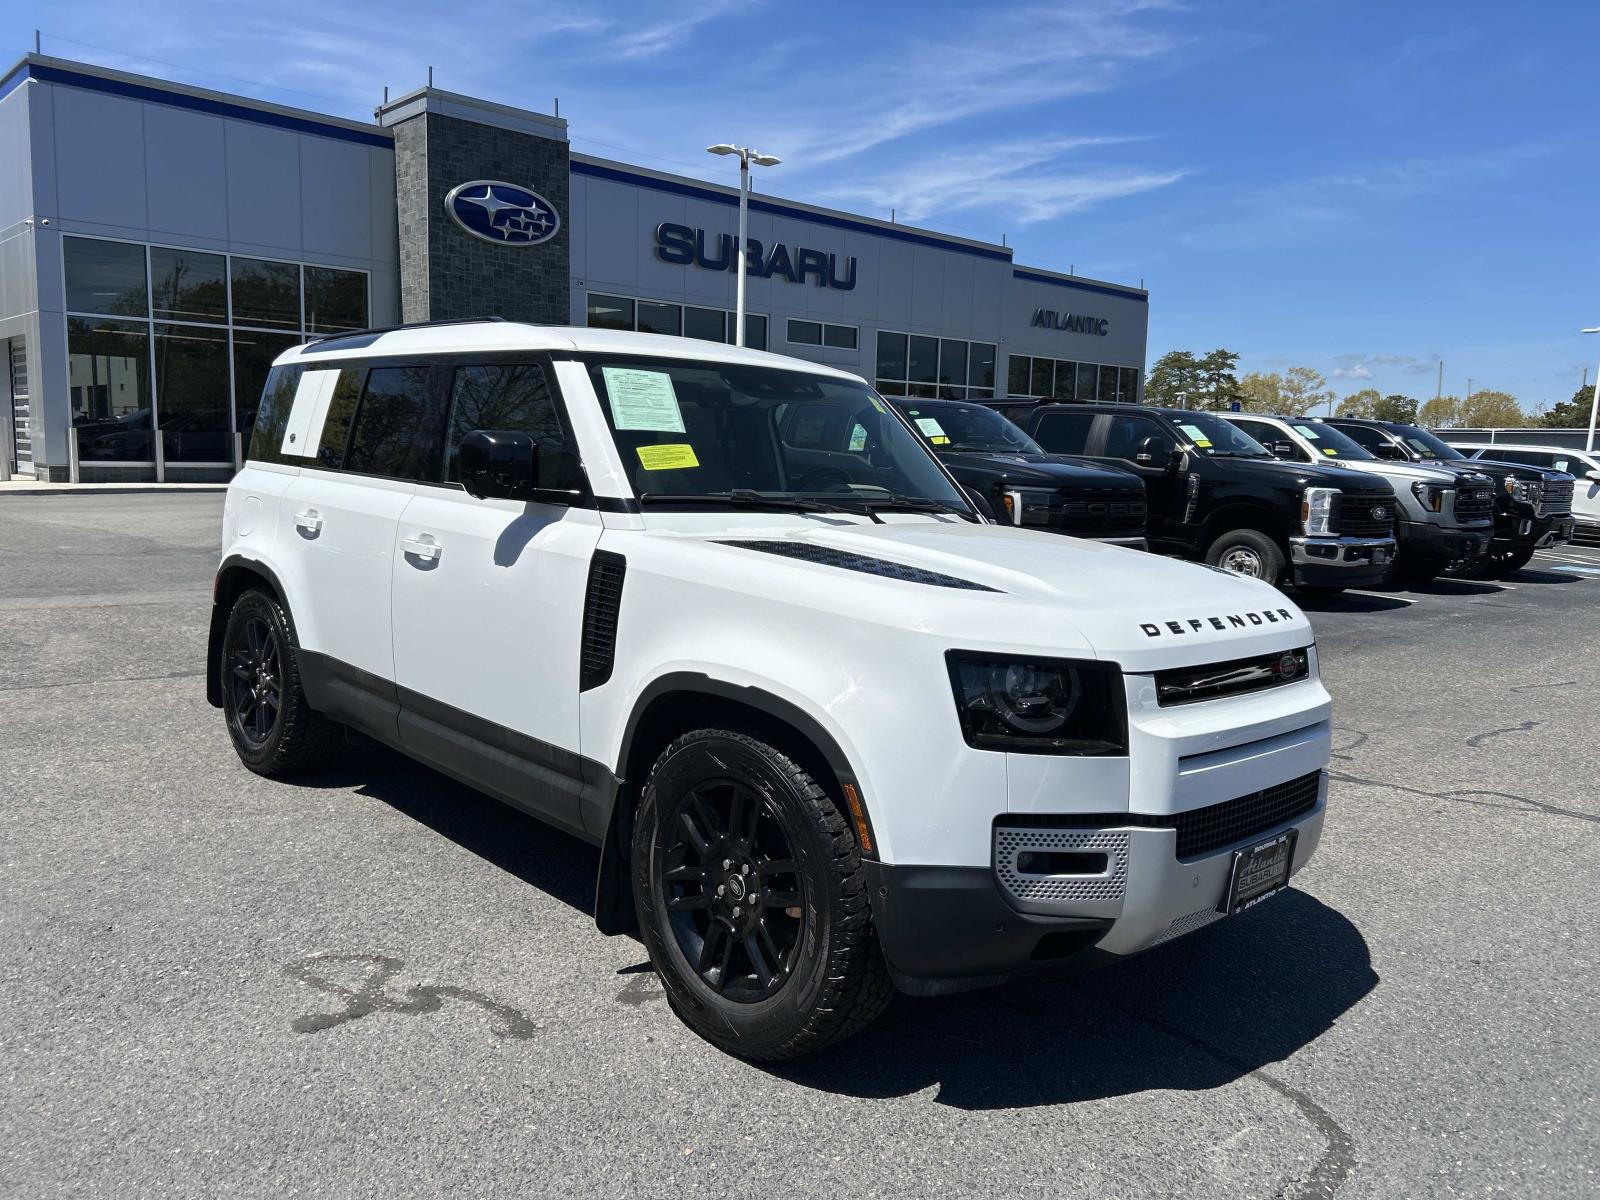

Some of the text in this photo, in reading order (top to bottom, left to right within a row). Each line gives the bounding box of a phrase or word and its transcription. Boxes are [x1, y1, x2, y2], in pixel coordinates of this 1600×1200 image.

[655, 222, 857, 291] SUBARU
[1031, 307, 1109, 337] ATLANTIC
[1139, 608, 1294, 638] DEFENDER
